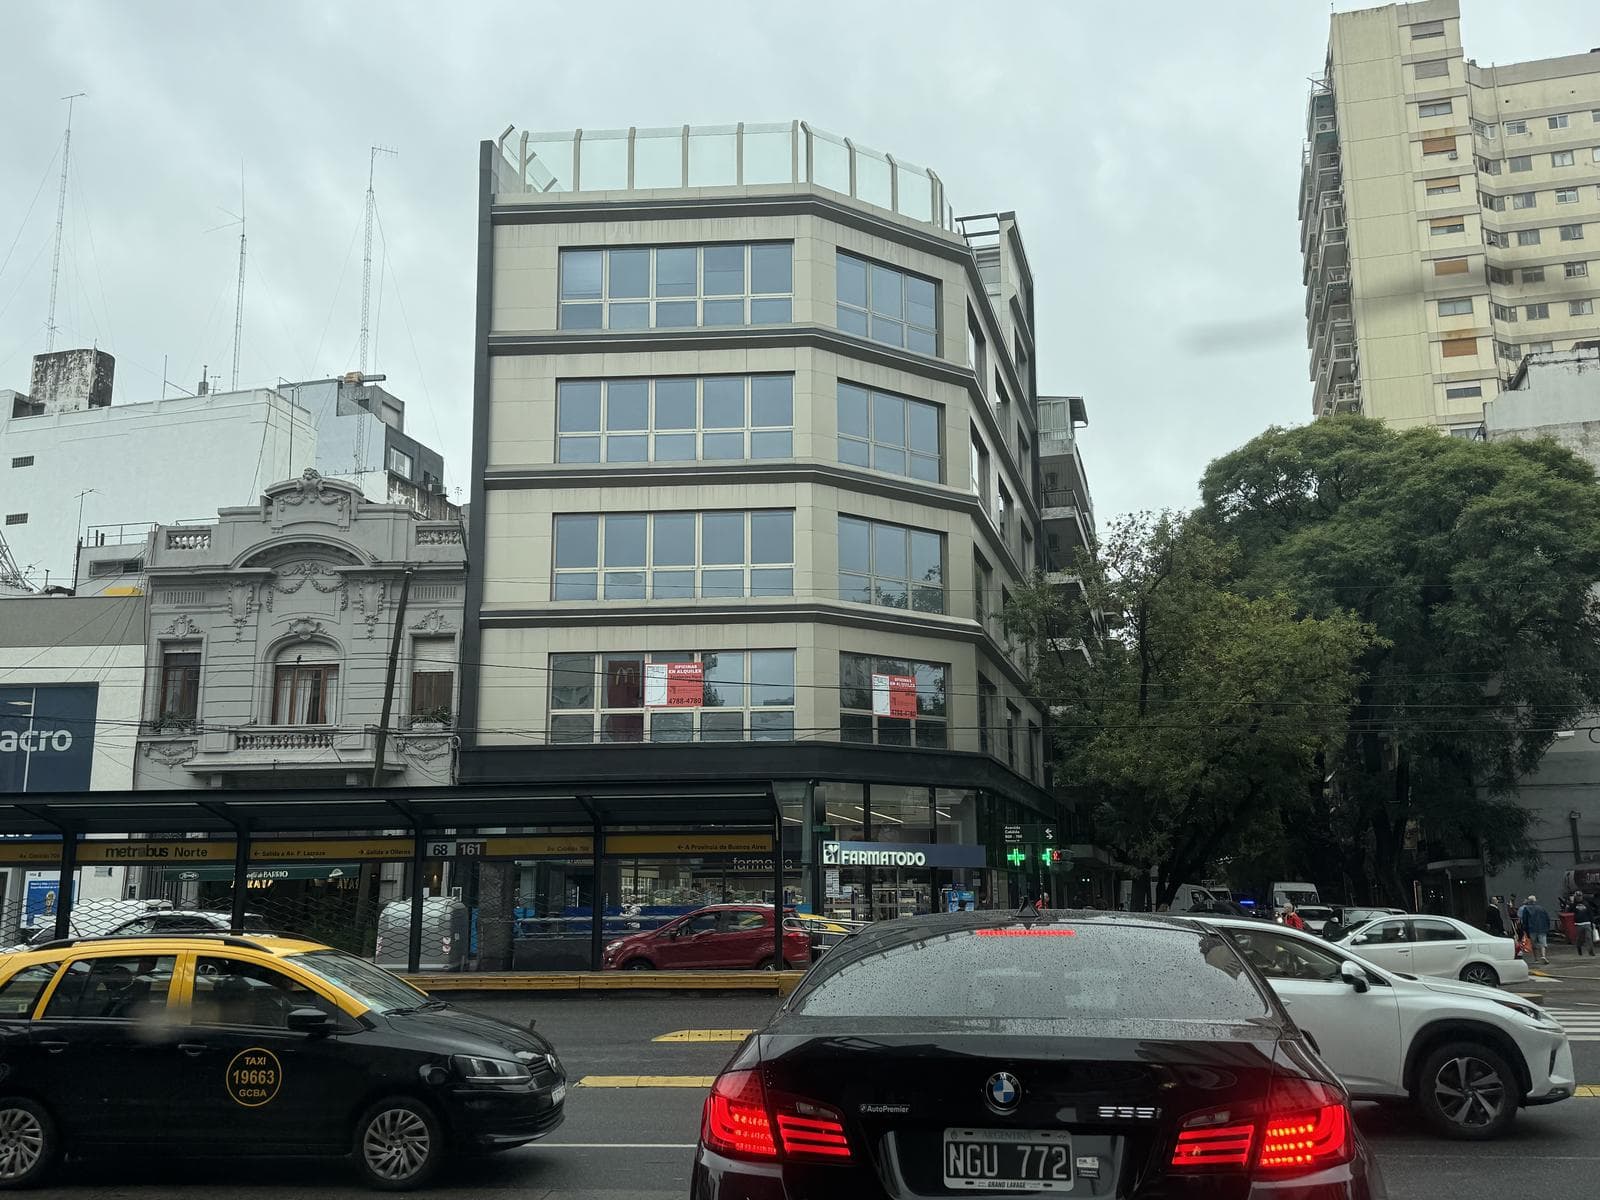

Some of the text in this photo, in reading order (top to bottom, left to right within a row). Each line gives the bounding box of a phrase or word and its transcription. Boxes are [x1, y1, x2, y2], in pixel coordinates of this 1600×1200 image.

[174, 846, 208, 857] Norte
[433, 844, 448, 856] 68
[460, 843, 481, 856] 161
[733, 857, 793, 870] farmaa
[841, 850, 926, 867] FARMATODO
[245, 1057, 266, 1065] TAXI
[233, 1070, 274, 1085] 19663
[239, 1089, 267, 1097] GCBA
[866, 1104, 910, 1113] AutoPremier
[982, 1130, 1032, 1141] ARGENTINA
[949, 1143, 1068, 1179] NGU 772
